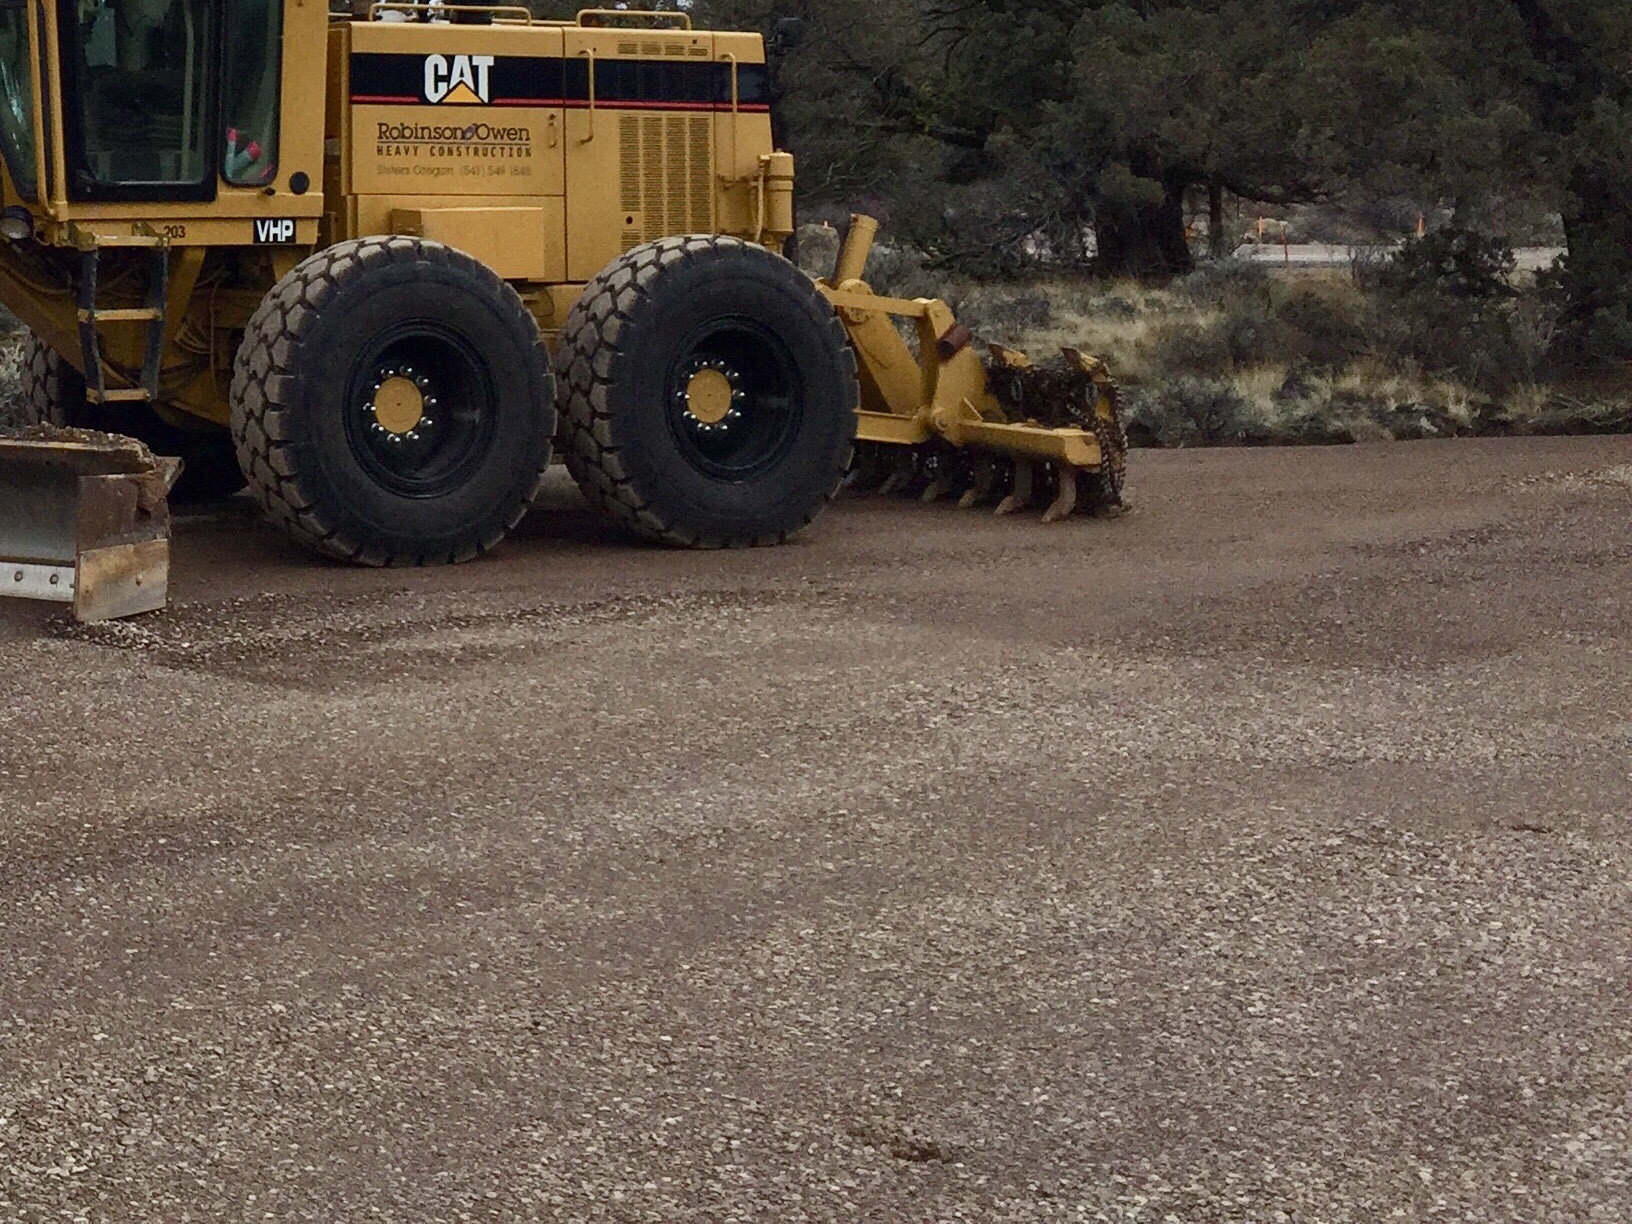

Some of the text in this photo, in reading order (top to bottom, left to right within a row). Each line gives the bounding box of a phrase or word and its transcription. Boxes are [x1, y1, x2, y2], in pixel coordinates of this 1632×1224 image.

[424, 54, 494, 104] CAT
[475, 123, 531, 142] Owen
[376, 145, 532, 158] HEAVY CONSTRUCTION
[256, 219, 294, 242] VHP
